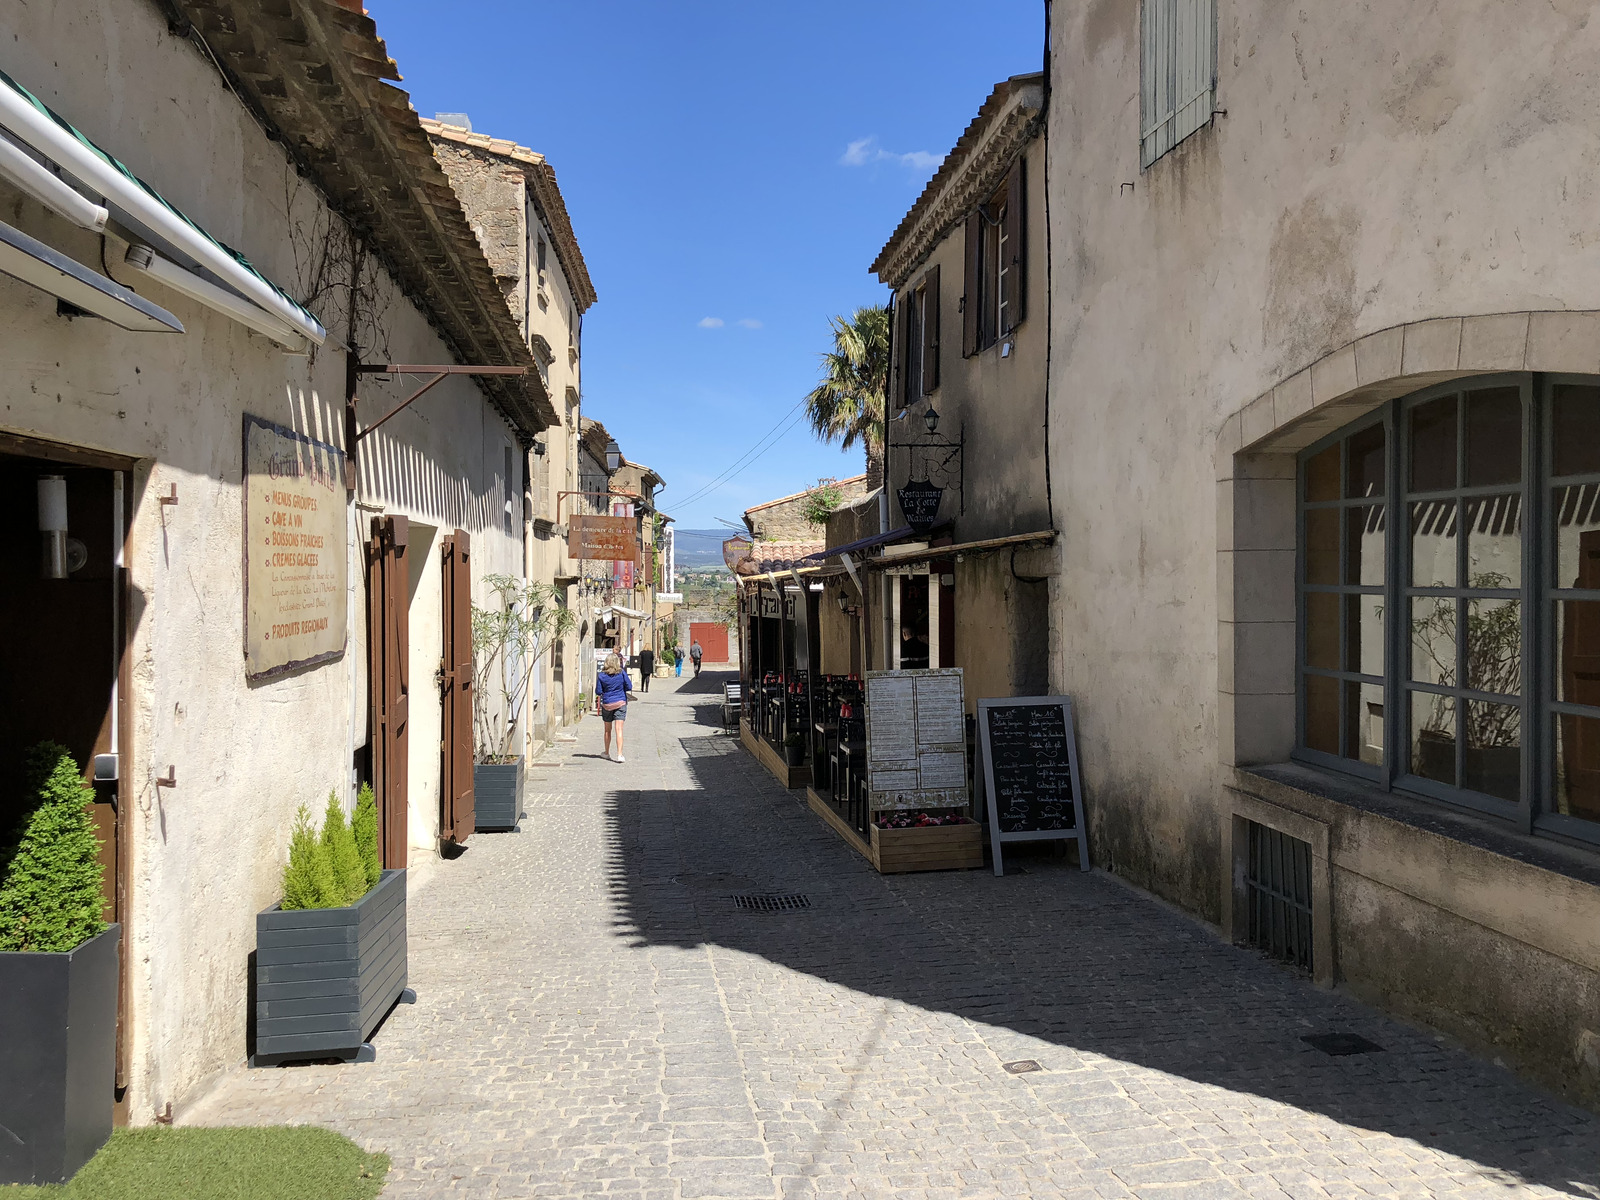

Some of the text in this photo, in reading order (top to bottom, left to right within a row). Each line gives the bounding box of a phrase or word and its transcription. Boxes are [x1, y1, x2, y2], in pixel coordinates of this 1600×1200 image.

[272, 490, 292, 507] MENUS
[898, 489, 942, 498] Restaurant
[904, 498, 914, 508] La
[272, 511, 303, 528] CAVE A VIN
[272, 531, 324, 548] BOISSONS FRAICHES
[272, 552, 319, 567] CREMES GLACEES
[272, 616, 329, 639] PRODUITS REGIONAUX
